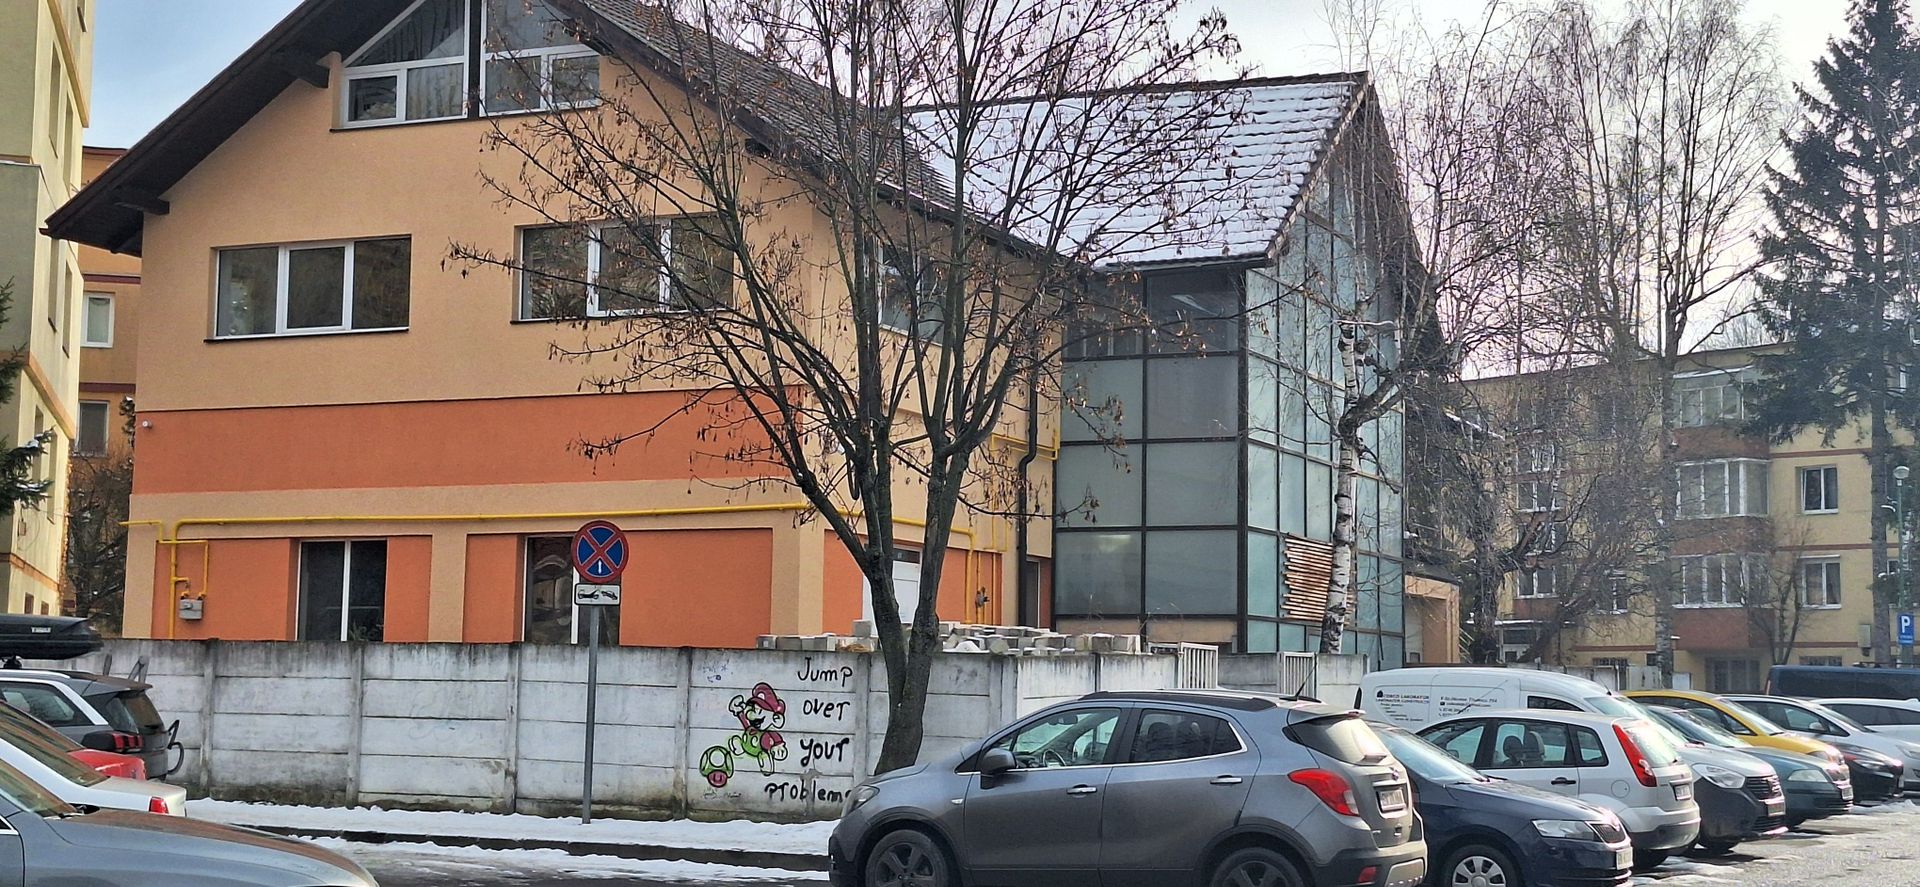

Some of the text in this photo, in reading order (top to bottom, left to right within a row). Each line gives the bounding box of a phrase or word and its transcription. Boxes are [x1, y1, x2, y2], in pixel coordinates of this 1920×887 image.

[1901, 615, 1911, 634] P
[797, 656, 853, 688] Jump
[803, 698, 851, 721] over
[800, 737, 850, 767] your
